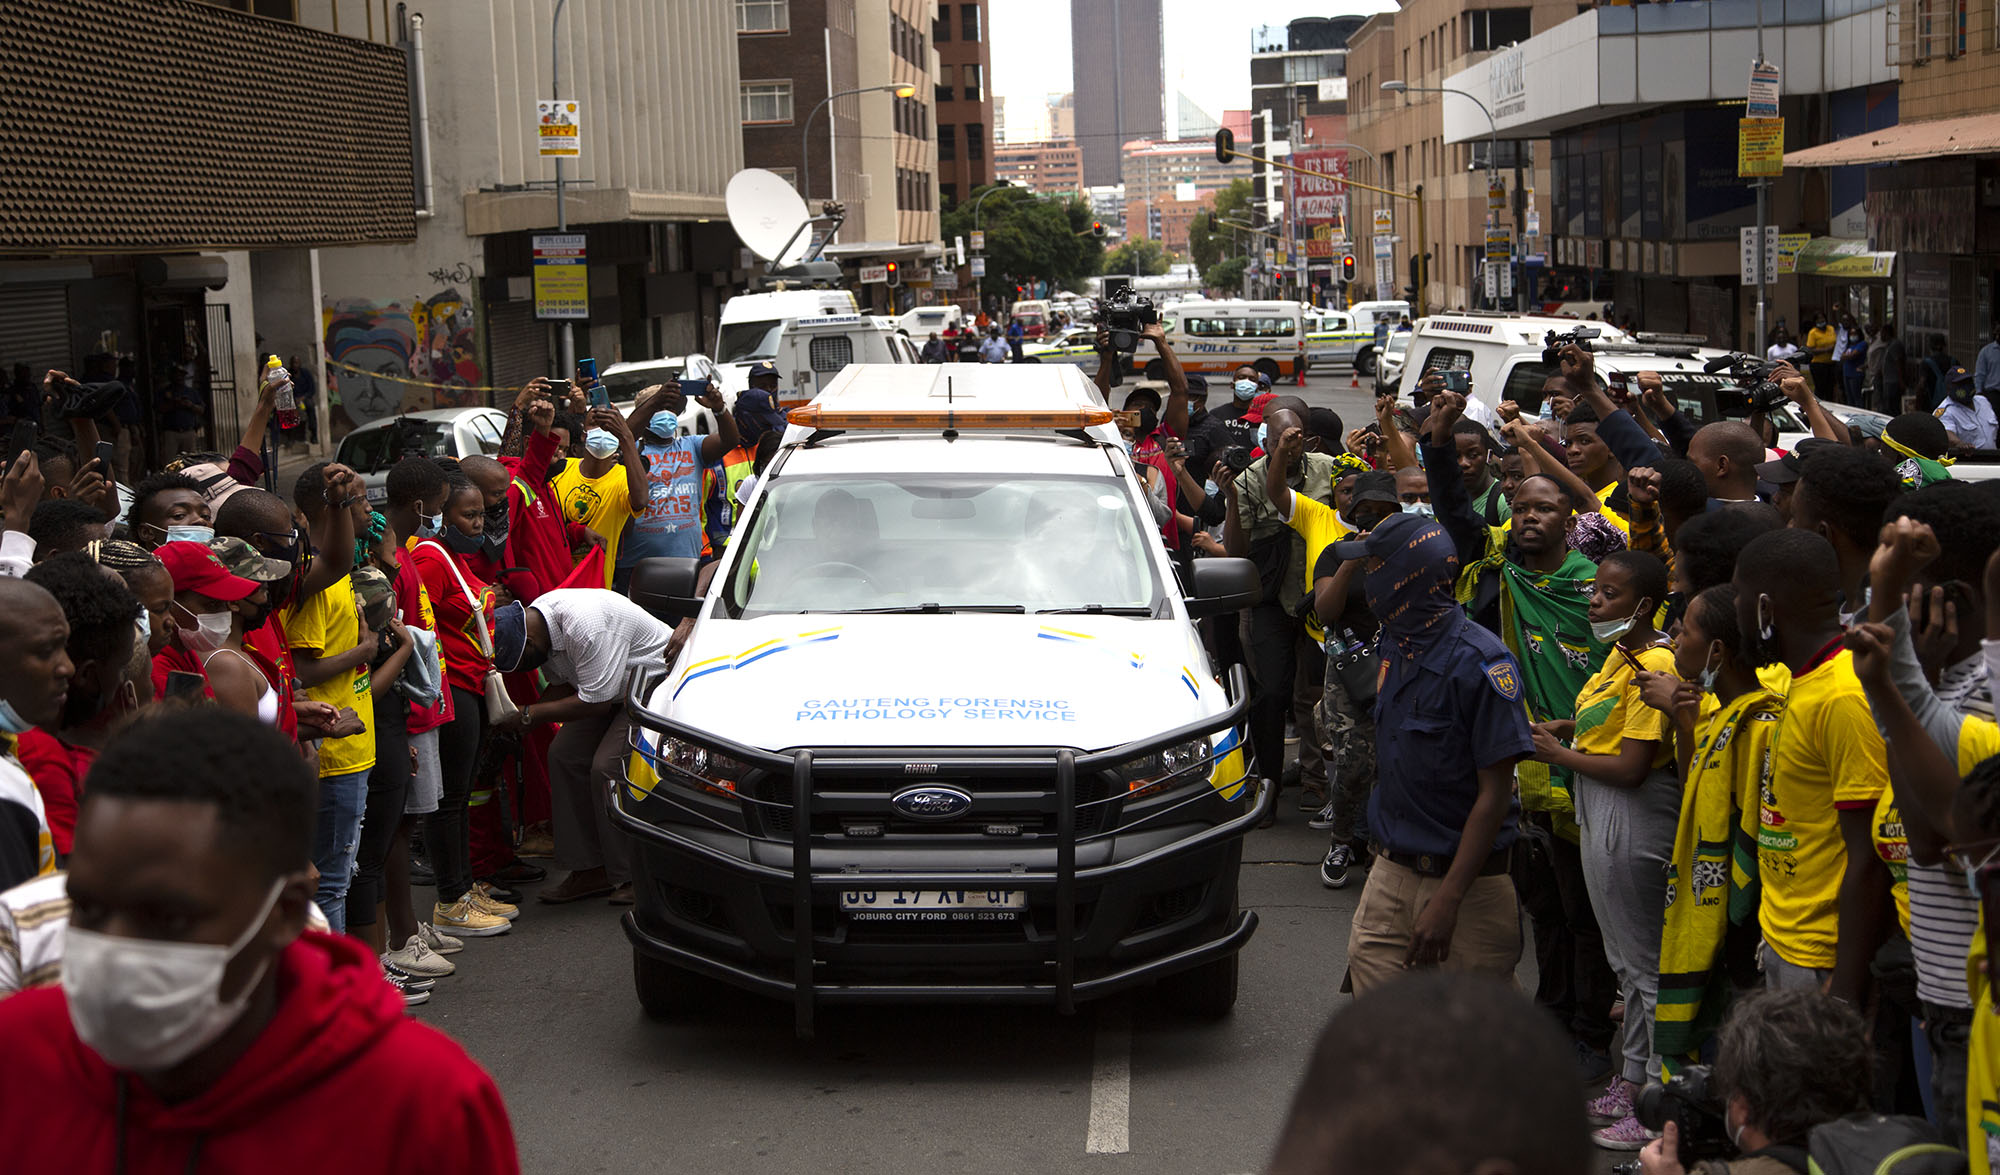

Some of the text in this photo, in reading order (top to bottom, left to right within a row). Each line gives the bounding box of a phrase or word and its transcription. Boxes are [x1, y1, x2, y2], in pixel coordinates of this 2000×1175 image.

[1304, 157, 1339, 173] IT'S THE
[1745, 230, 1753, 283] BOSTON
[1766, 228, 1775, 282] BOSTON
[862, 269, 886, 281] LEGIT
[799, 317, 828, 325] METRO
[1192, 343, 1240, 353] POLICE
[803, 697, 1070, 710] GAUTENG FORENSIC
[795, 708, 1077, 722] PATHOLOGY SERVICE
[904, 764, 939, 775] RHINO
[909, 792, 953, 812] Ford
[1702, 896, 1720, 907] ANC
[853, 912, 1016, 922] JOBURG CITY FORD 0861 523 673
